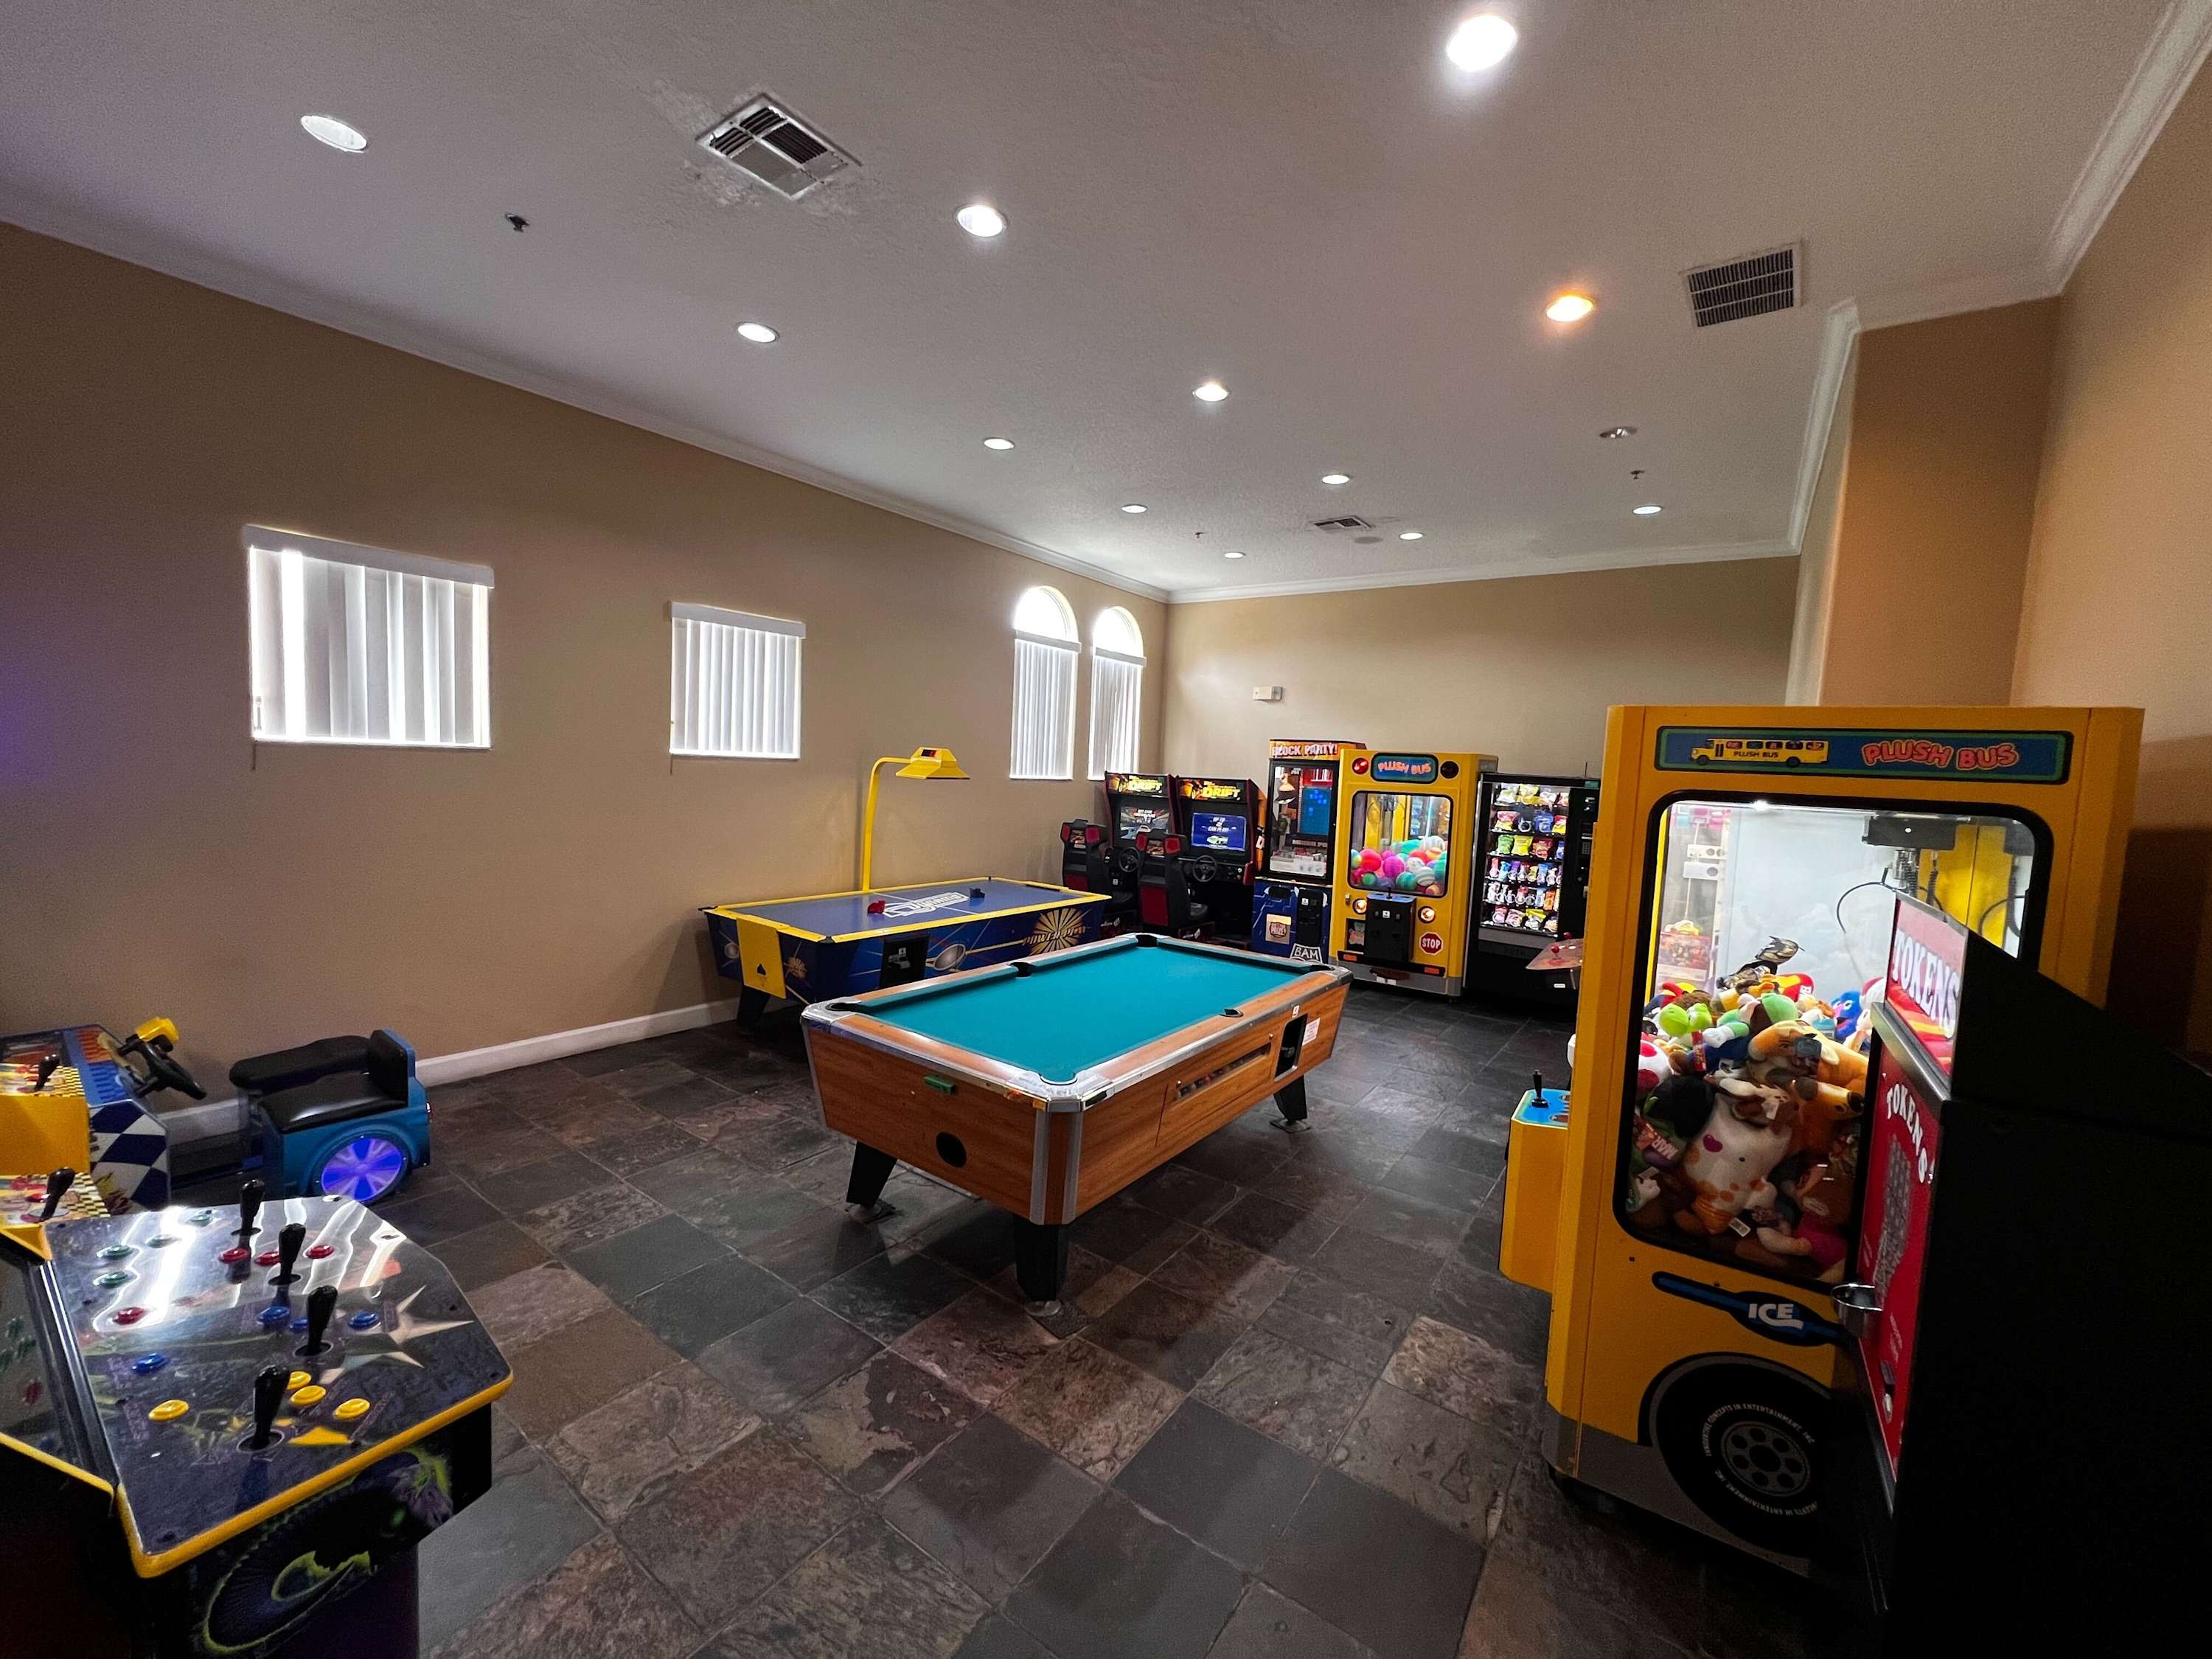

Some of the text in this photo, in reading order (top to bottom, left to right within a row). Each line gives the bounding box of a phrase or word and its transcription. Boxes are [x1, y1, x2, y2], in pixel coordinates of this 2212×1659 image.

[1304, 742, 1338, 756] PARTY!
[1761, 751, 1779, 759] BUS
[1861, 740, 2020, 770] PLUSH BUS
[1377, 761, 1431, 774] PLUSH BUS
[1202, 787, 1240, 798] DRIFT
[1422, 937, 1441, 948] STOP
[1294, 947, 1319, 960] BAM
[1892, 928, 1961, 1039] TOKENS
[1748, 1304, 1804, 1330] ICE
